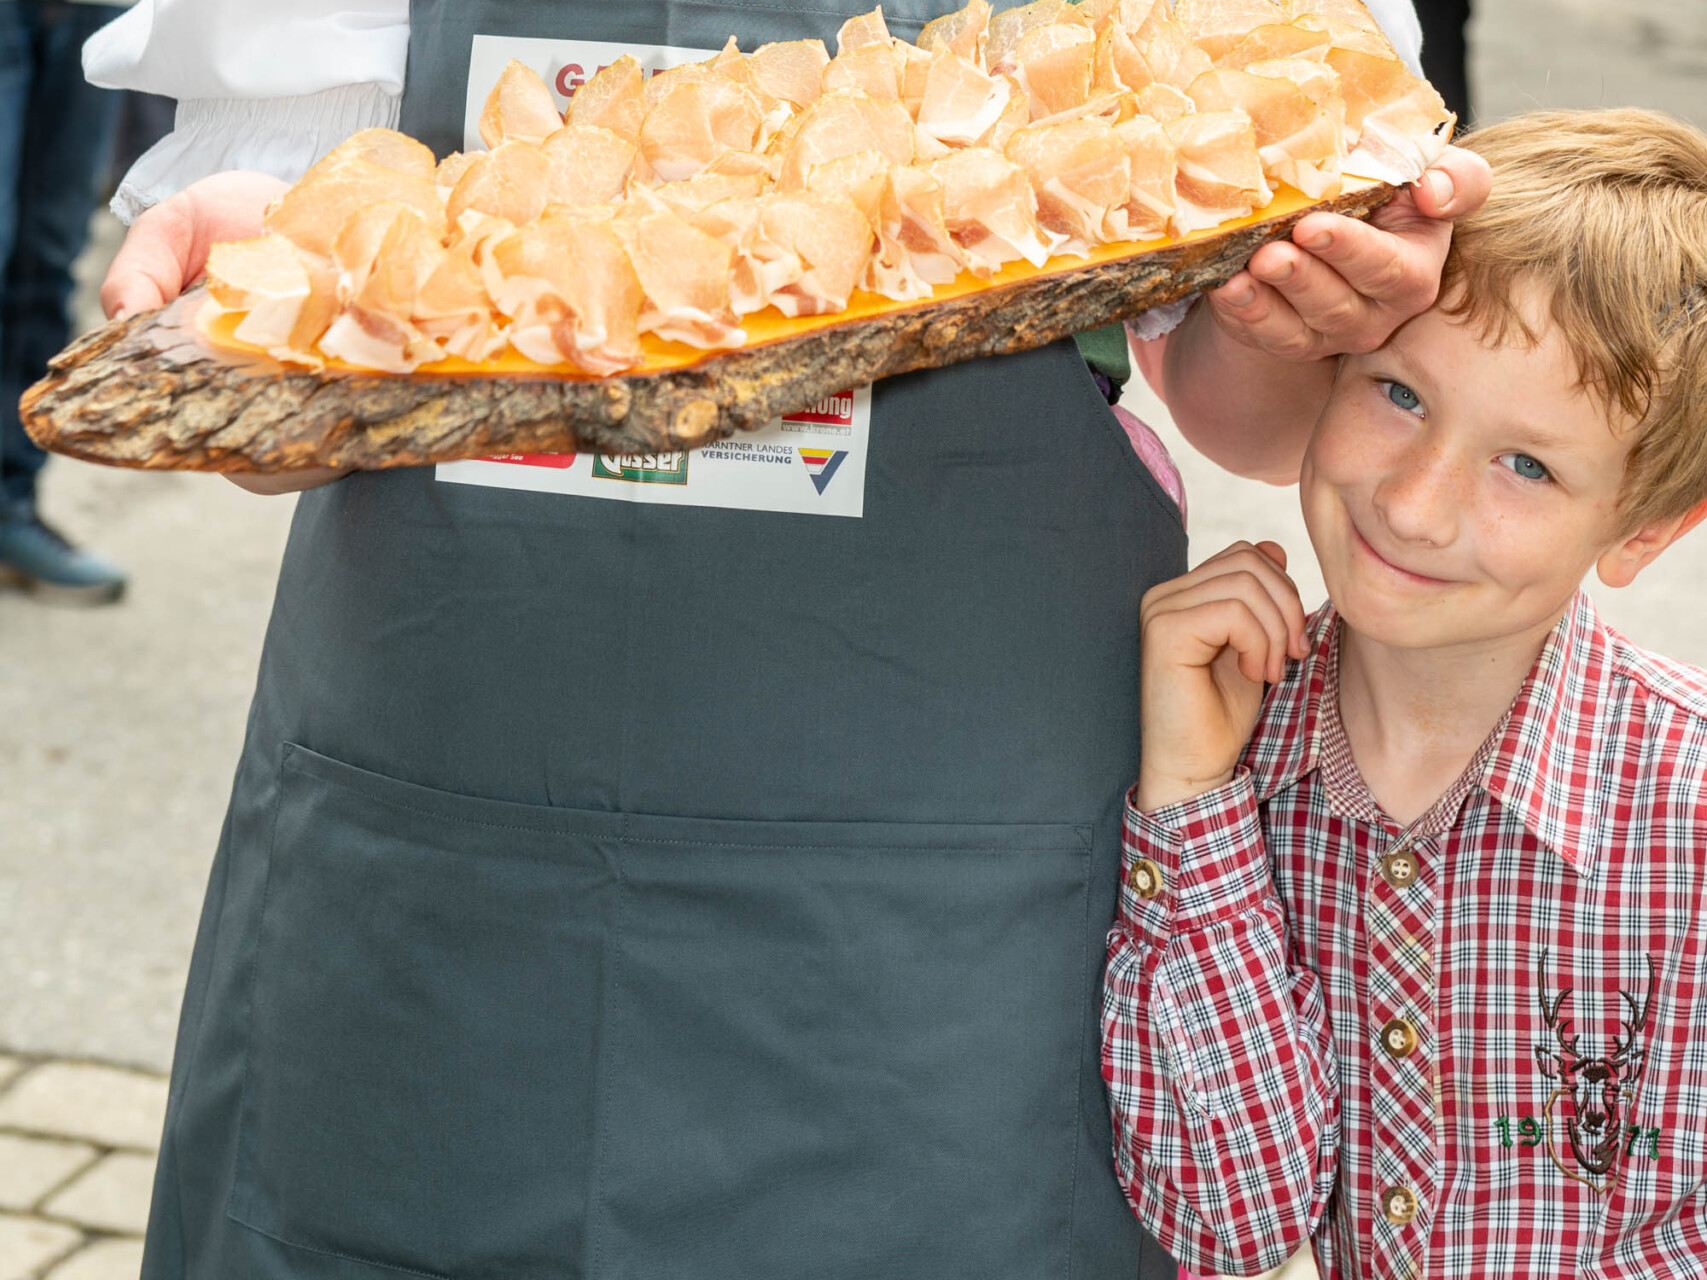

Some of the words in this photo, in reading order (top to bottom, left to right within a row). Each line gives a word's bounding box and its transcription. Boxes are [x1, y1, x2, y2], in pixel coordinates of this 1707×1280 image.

[757, 444, 793, 455] LANDES
[701, 450, 792, 465] VERSICHERUNG
[1494, 1116, 1542, 1148] 19
[1626, 1124, 1661, 1161] 71
